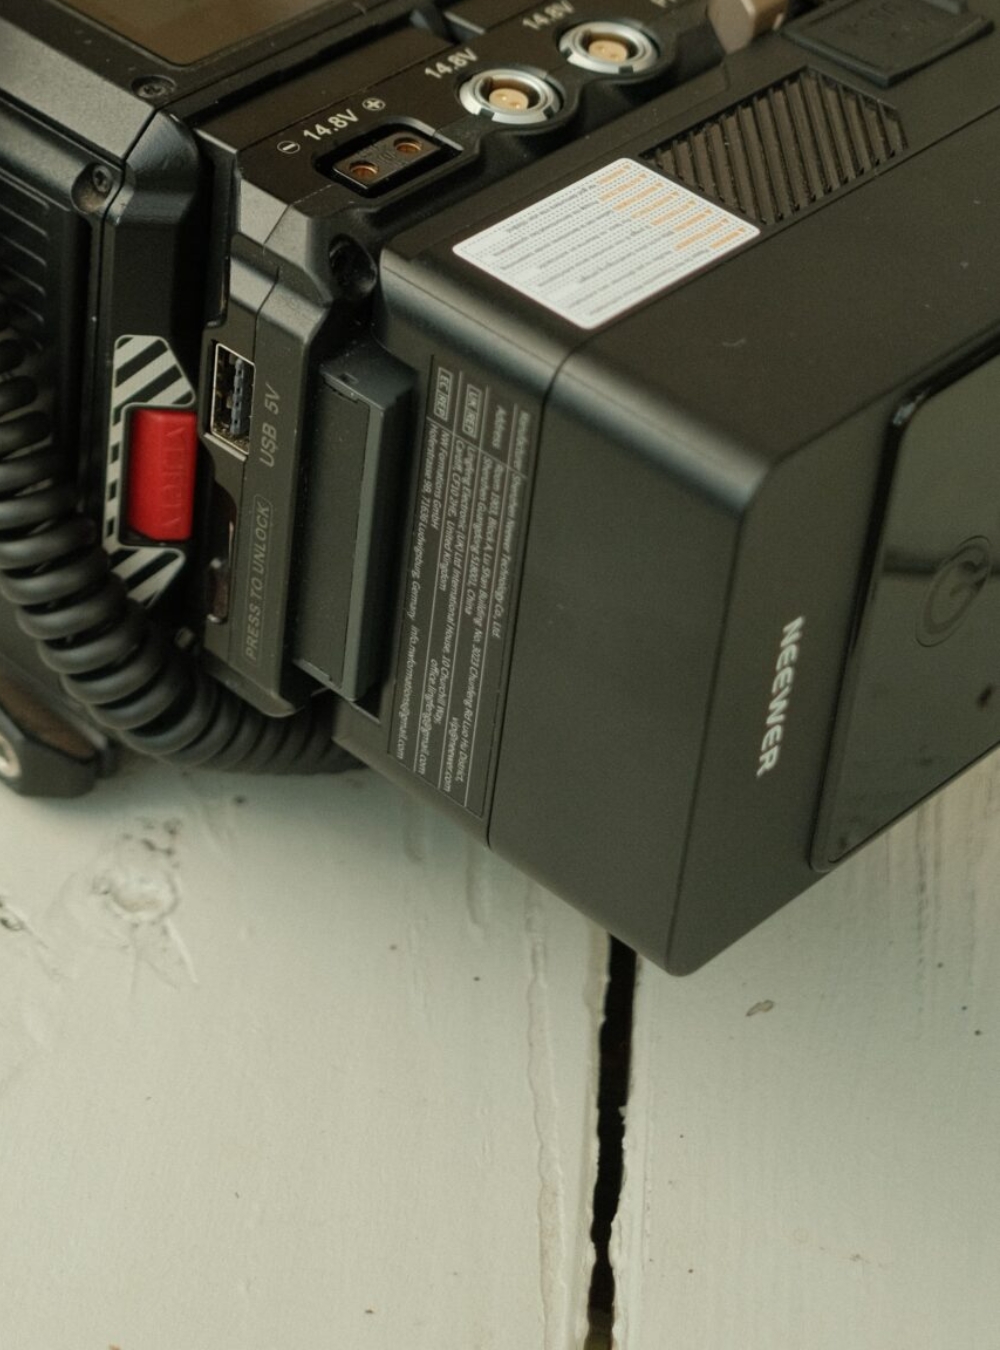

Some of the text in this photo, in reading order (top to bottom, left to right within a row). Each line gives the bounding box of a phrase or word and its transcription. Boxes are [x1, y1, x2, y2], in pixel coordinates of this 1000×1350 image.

[521, 0, 575, 32] 14.8V
[424, 48, 479, 81] 14.8V
[302, 107, 360, 143] 14.8V
[259, 383, 281, 468] USB 5V
[492, 406, 506, 448] Address
[245, 501, 270, 661] PRESS TO UNLOCK
[465, 589, 475, 615] China
[756, 616, 805, 778] NEEWER
